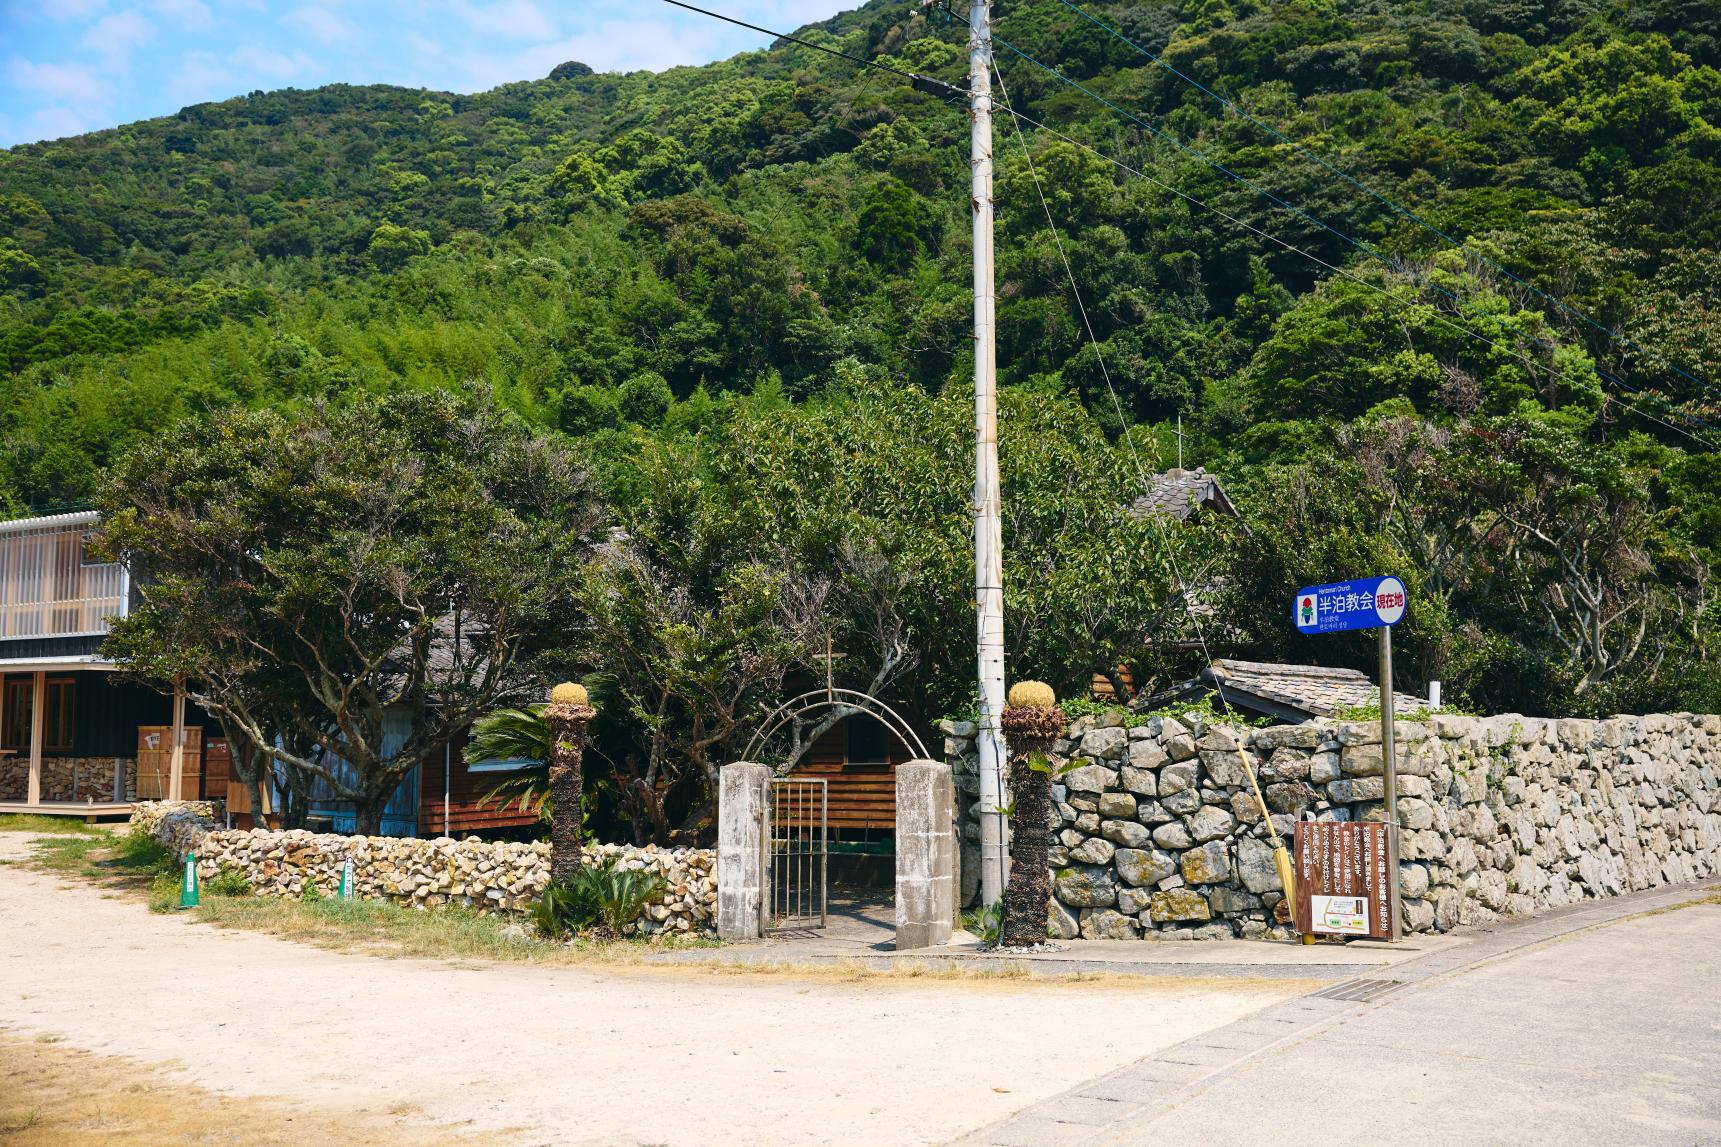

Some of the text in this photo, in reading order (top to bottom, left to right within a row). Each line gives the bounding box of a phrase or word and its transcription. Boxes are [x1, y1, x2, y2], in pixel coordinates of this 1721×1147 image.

[1319, 591, 1374, 615] 半泊教会
[1377, 592, 1404, 609] 現在地
